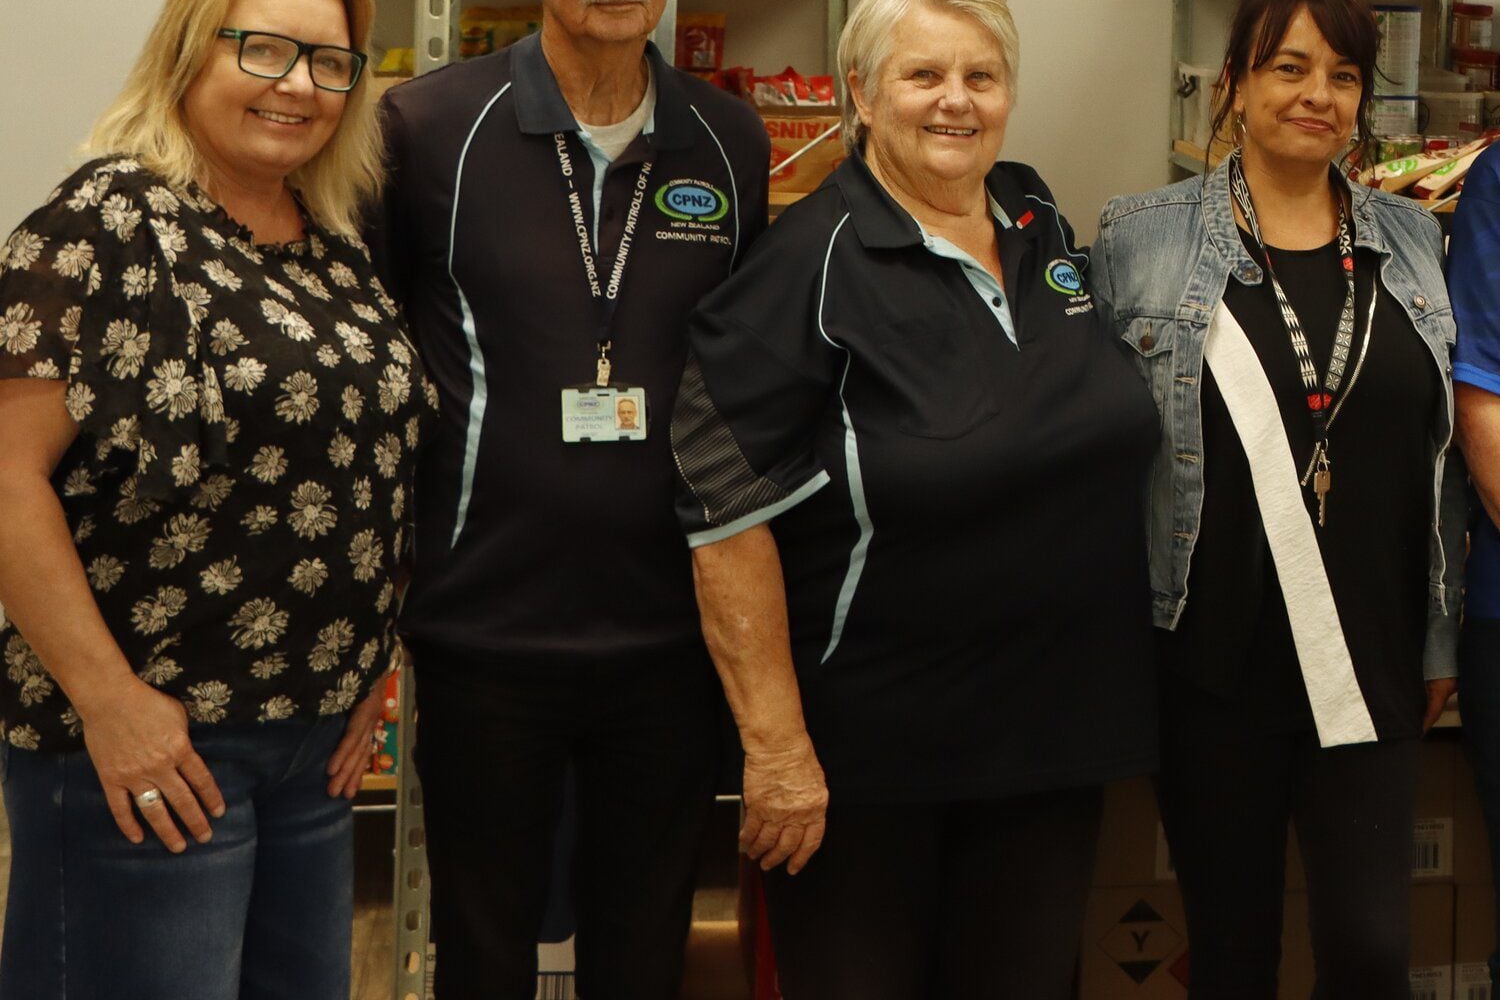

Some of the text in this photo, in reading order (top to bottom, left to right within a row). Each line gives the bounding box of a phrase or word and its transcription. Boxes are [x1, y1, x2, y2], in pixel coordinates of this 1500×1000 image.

[672, 193, 712, 207] CPNZ
[688, 222, 720, 231] ZEALAND
[568, 192, 601, 297] WWW.CPNZ.ORG.NZ
[606, 234, 632, 300] COMMUNITY
[625, 190, 643, 234] PATROLS
[637, 174, 648, 190] OF
[656, 231, 706, 241] COMMUNITY
[1130, 930, 1150, 953] Y
